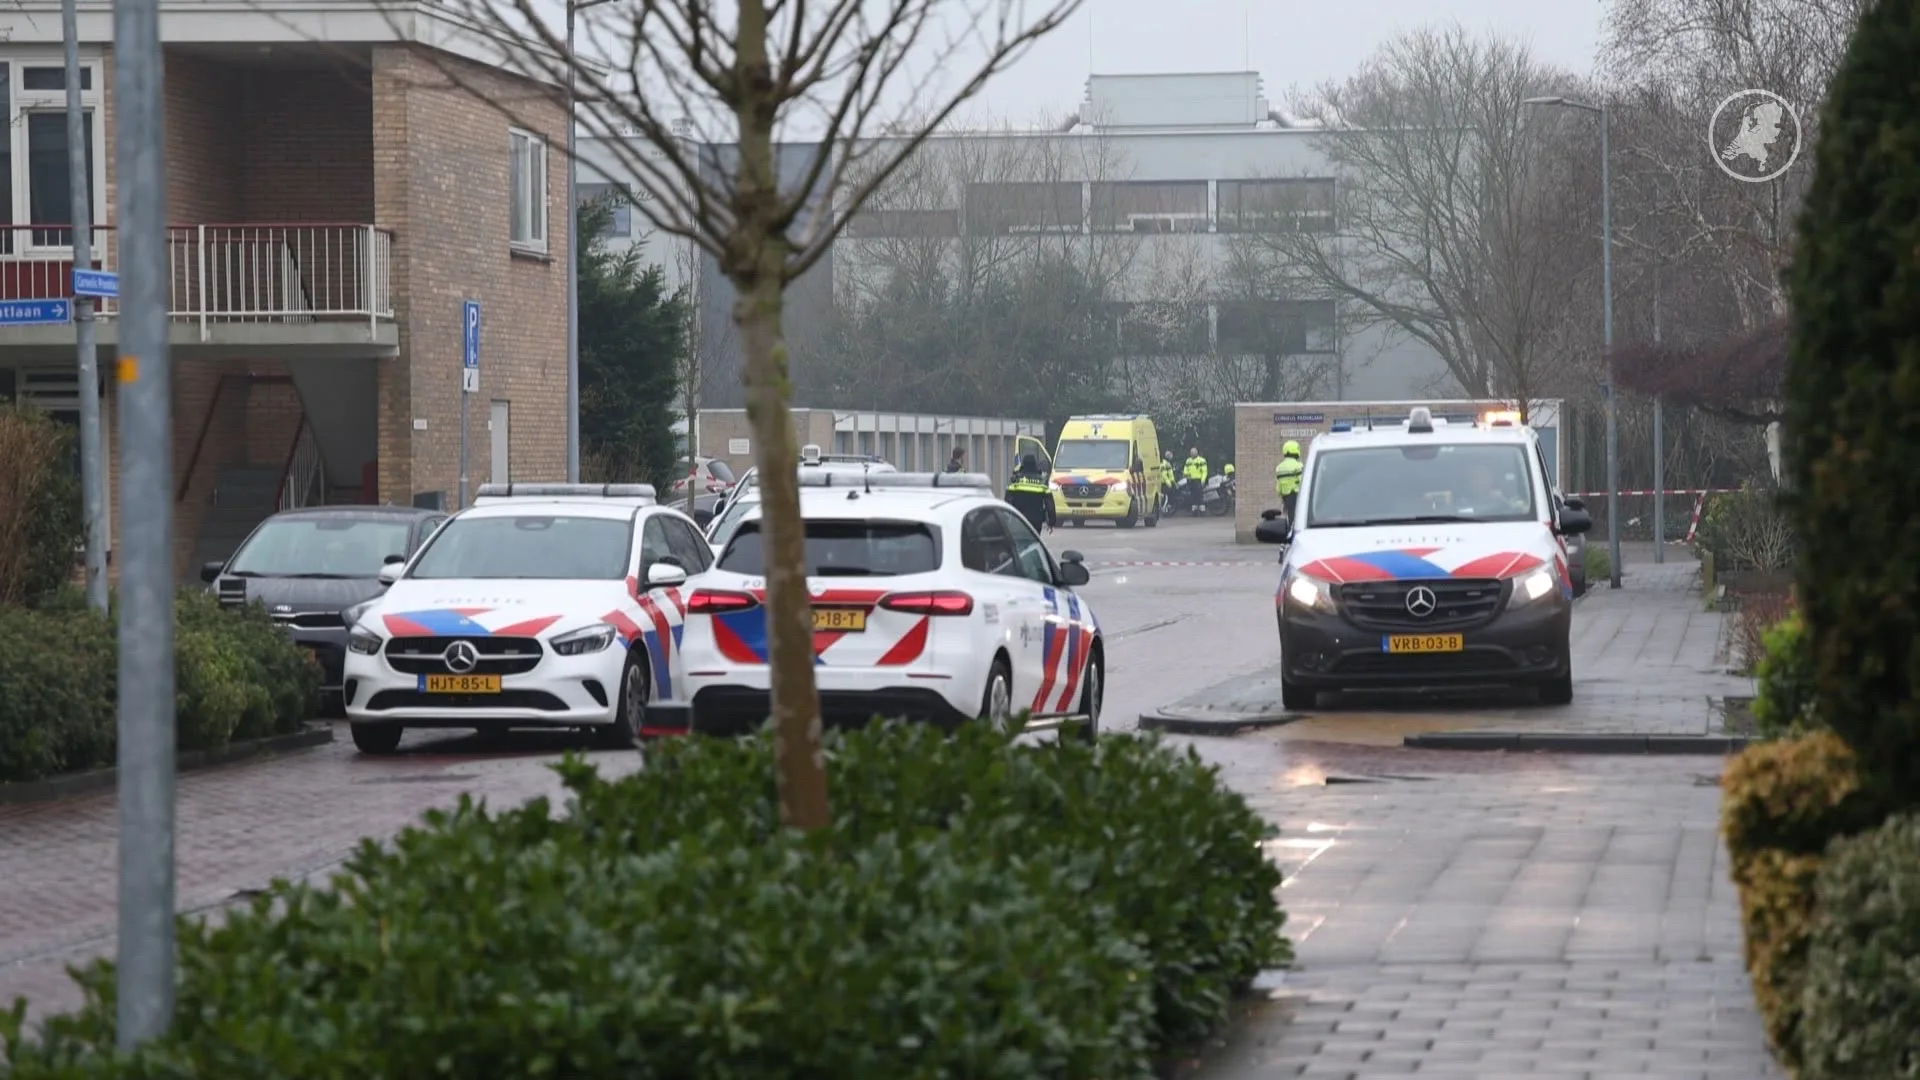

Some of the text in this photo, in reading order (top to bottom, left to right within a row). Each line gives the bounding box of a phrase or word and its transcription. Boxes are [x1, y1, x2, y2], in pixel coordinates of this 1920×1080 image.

[469, 306, 477, 339] P
[1392, 636, 1458, 650] VRB-03-B
[430, 677, 493, 690] HJT-85-L
